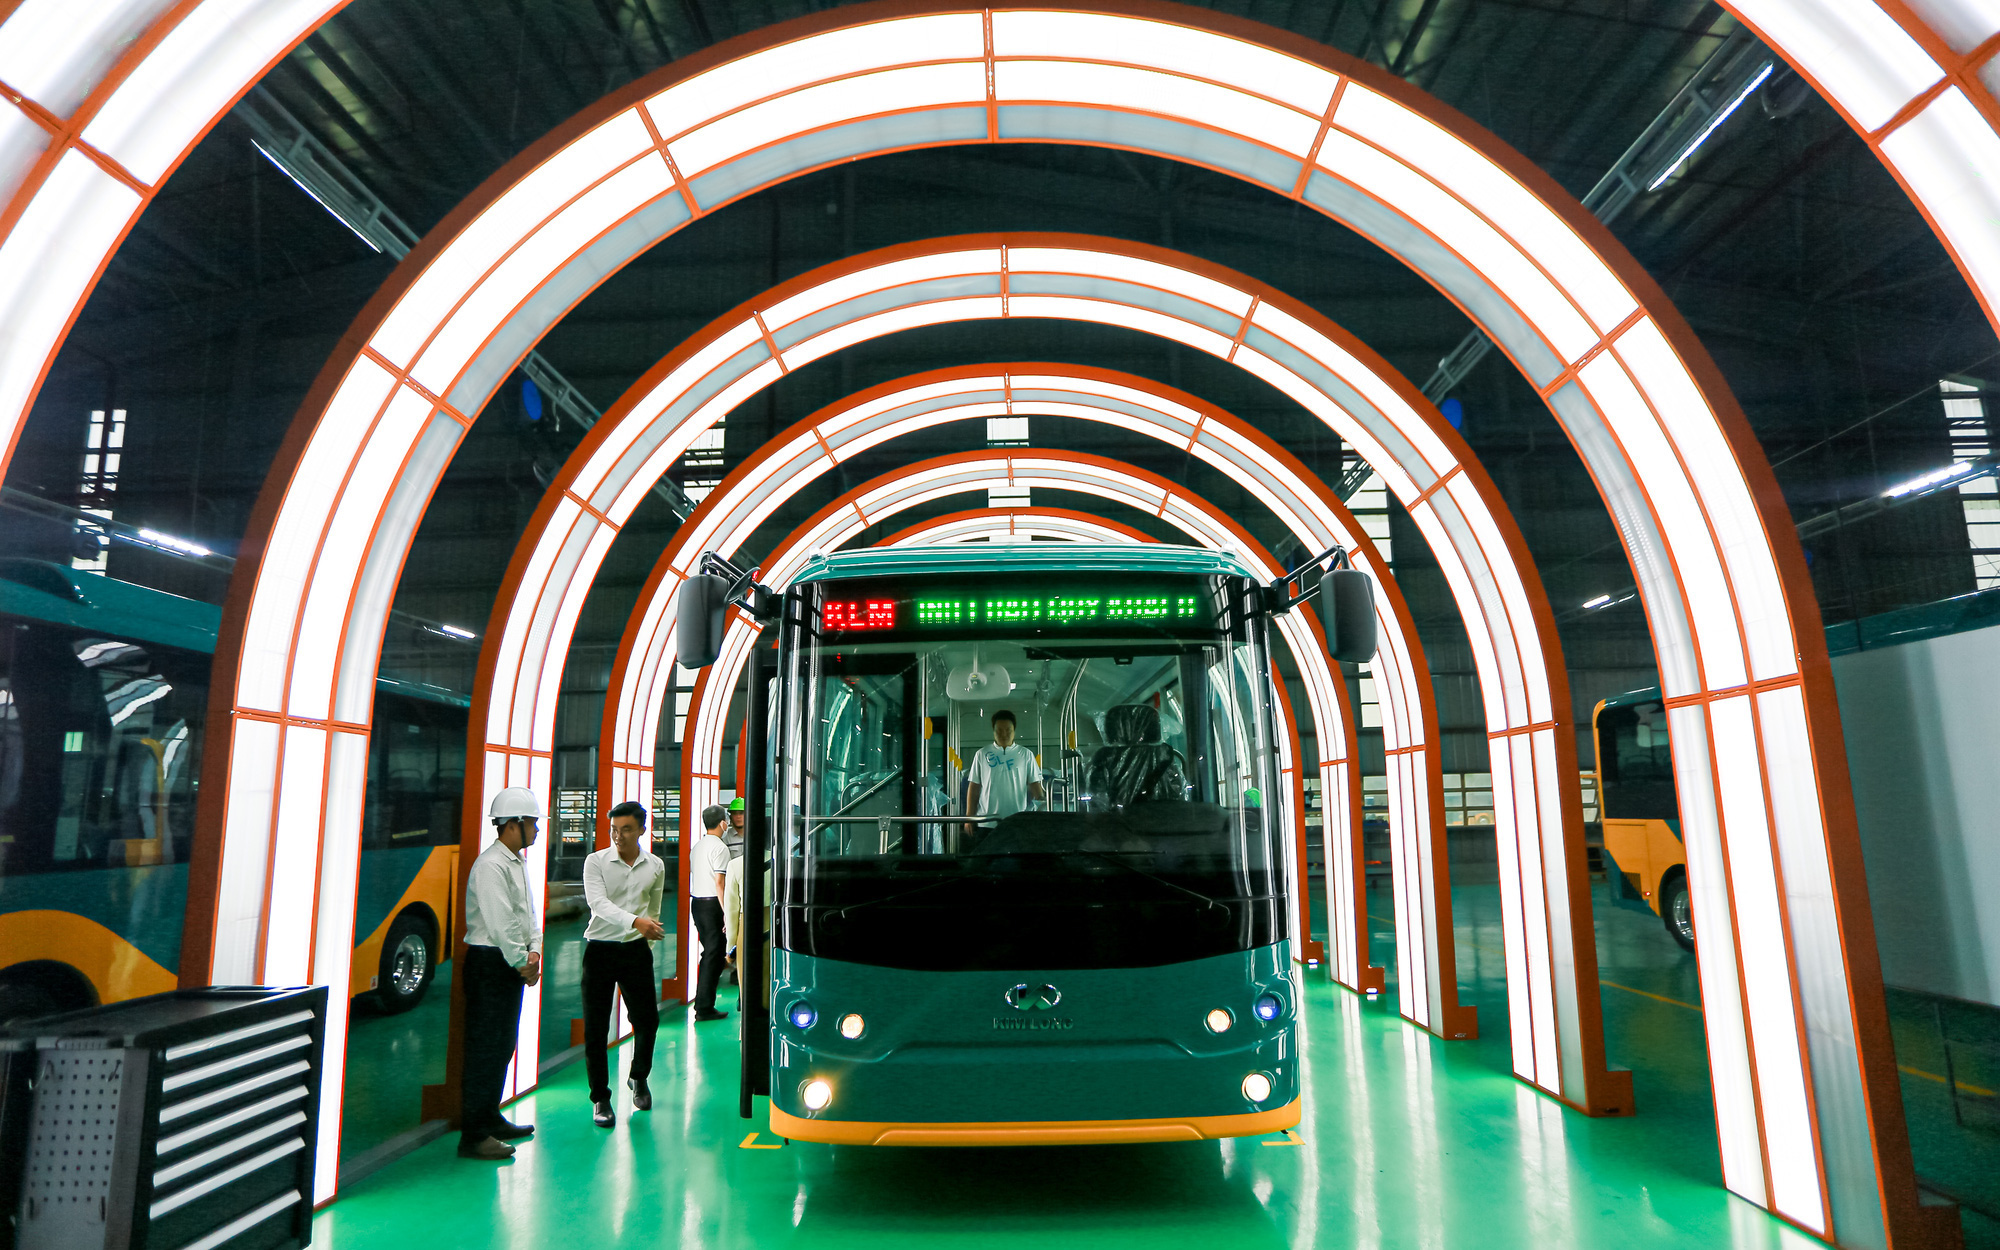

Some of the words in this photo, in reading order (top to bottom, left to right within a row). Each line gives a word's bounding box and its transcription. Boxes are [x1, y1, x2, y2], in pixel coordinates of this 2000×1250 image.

[825, 602, 893, 628] KLM
[993, 1017, 1026, 1029] KIM
[1029, 1017, 1074, 1029] LONG
